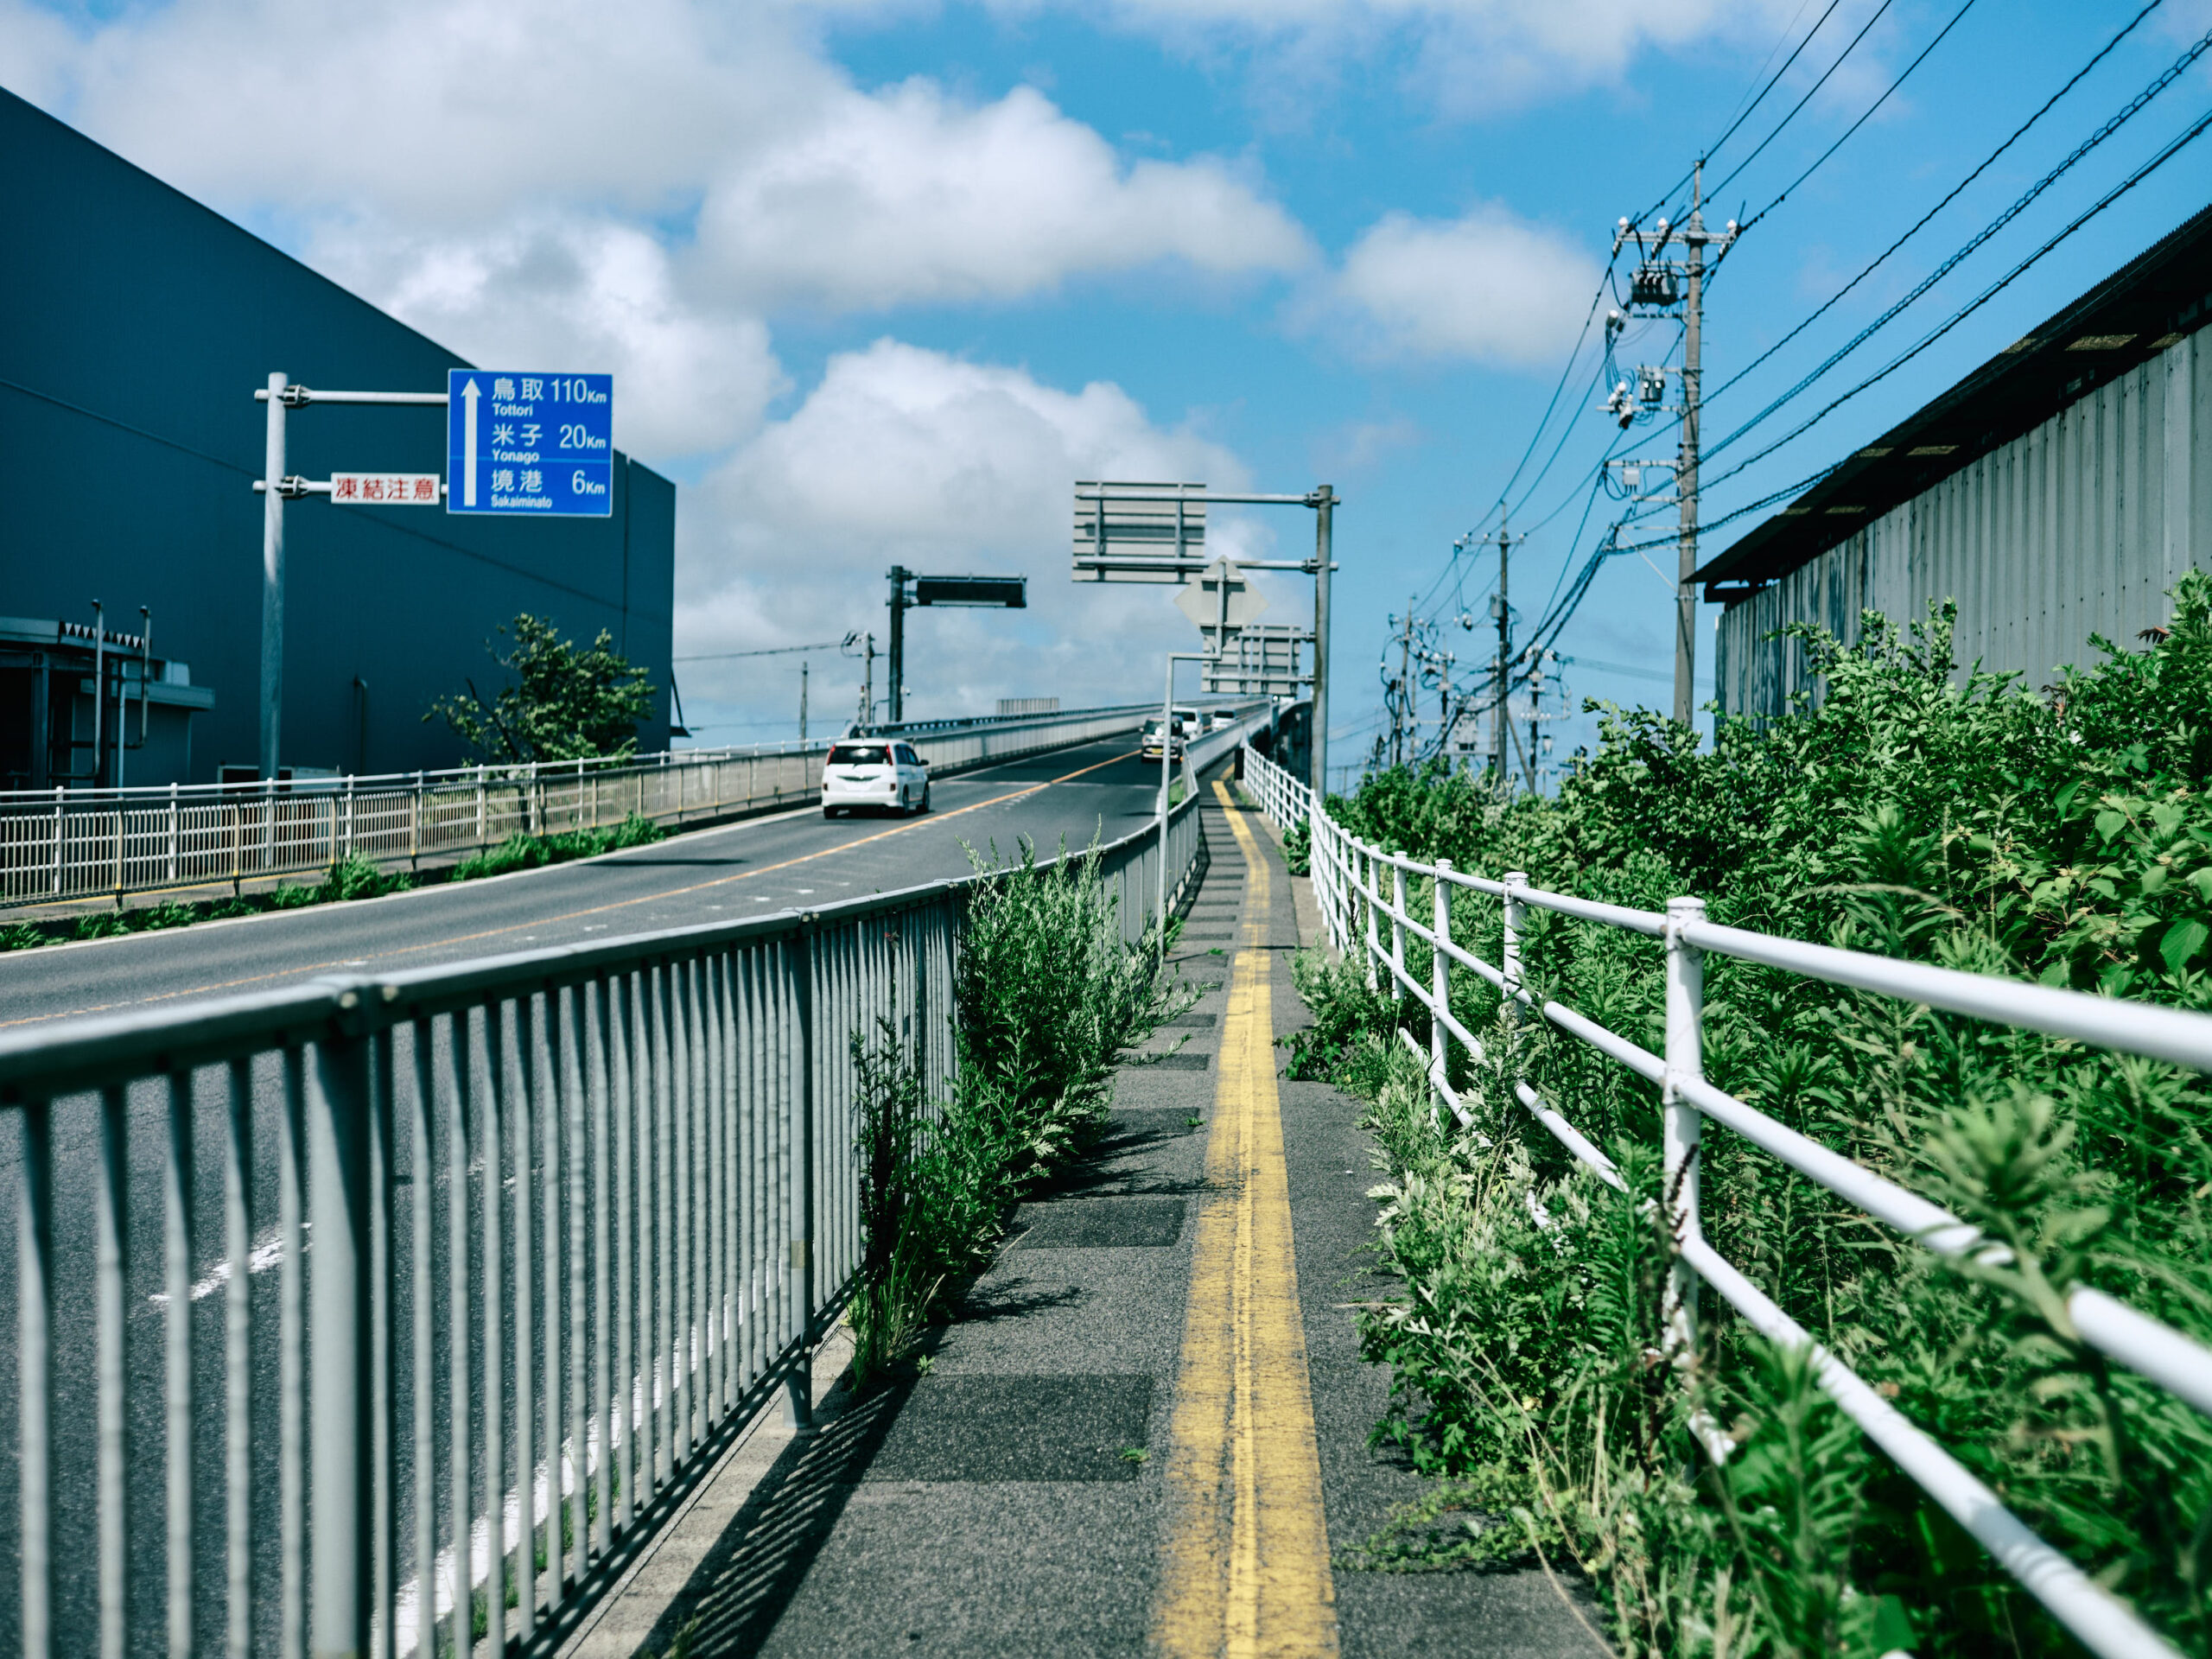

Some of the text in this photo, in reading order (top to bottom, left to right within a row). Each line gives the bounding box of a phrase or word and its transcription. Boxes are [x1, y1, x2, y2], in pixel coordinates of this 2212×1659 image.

[492, 378, 543, 401] 鳥取
[493, 404, 533, 416] Tottori
[492, 423, 543, 447] 米子
[492, 449, 539, 465] Yonago
[336, 478, 434, 499] 凍結注意
[491, 469, 543, 493] 境港
[492, 494, 552, 508] Sakaiminato
